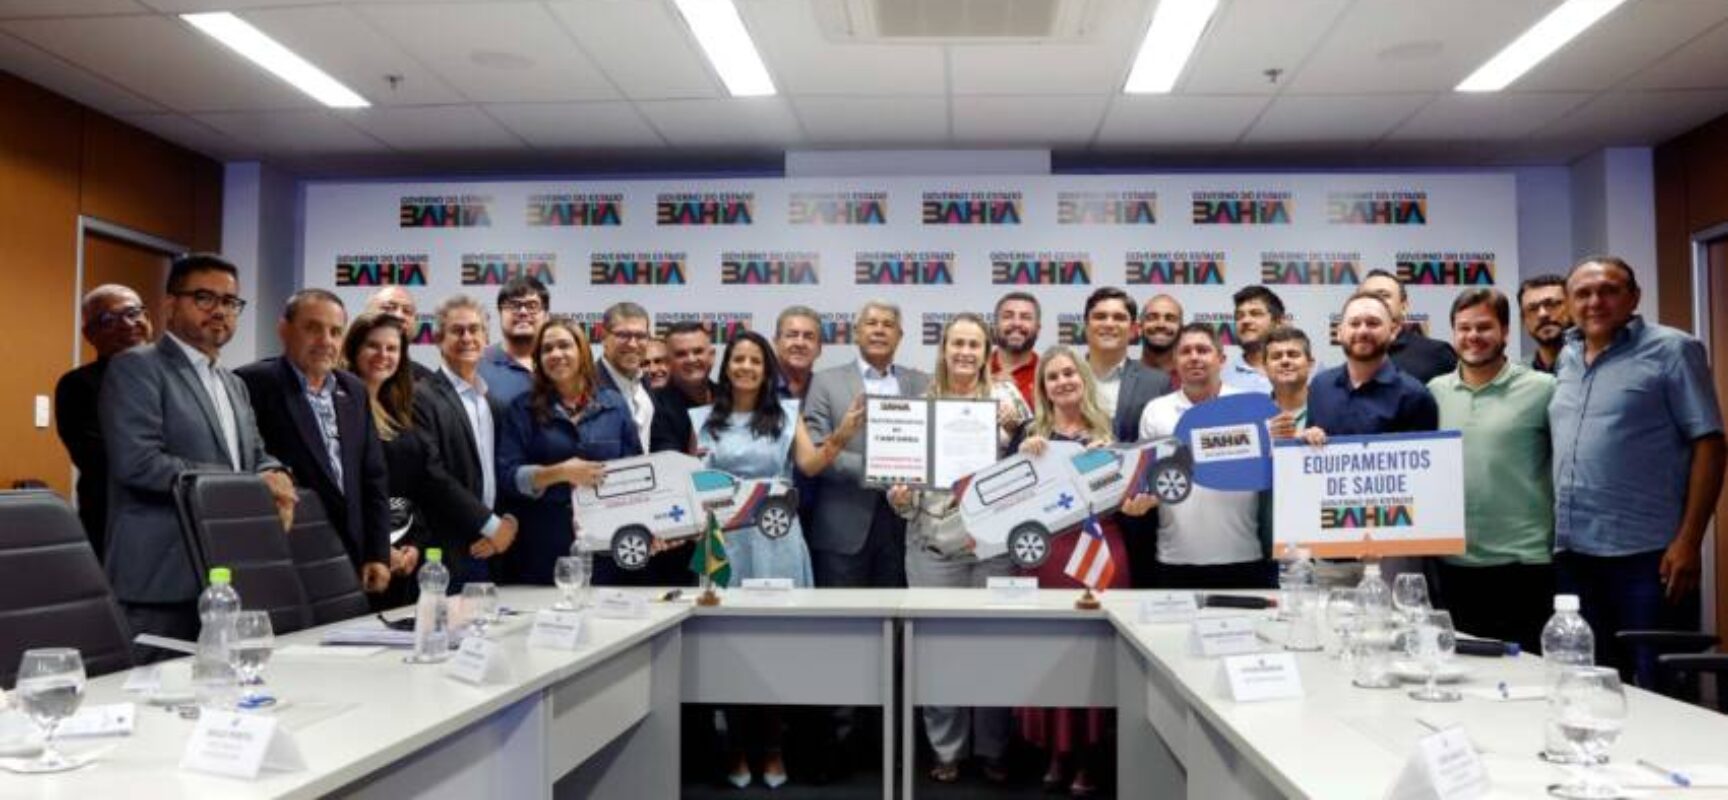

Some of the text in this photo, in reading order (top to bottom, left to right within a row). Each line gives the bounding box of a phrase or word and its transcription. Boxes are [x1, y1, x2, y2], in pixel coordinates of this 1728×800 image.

[400, 204, 491, 227] BAHIA
[527, 203, 622, 226] BAHIA
[656, 202, 752, 225] BAHIA
[922, 200, 1022, 224] BAHIA
[1193, 200, 1292, 224] BAHIA
[335, 263, 428, 286] BAHIA
[590, 261, 686, 285] BAHIA
[721, 261, 819, 285] BAHIA
[855, 261, 954, 285] BAHIA
[992, 261, 1092, 285] BAHIA
[1126, 261, 1224, 285] BAHIA
[1261, 261, 1360, 285] BAHIA
[1396, 261, 1495, 285] BAHIA
[1201, 434, 1250, 449] BAHIA
[1303, 450, 1431, 475] EQUIPAMENTOS
[1327, 476, 1348, 496] DE
[1321, 505, 1414, 528] BAHIA
